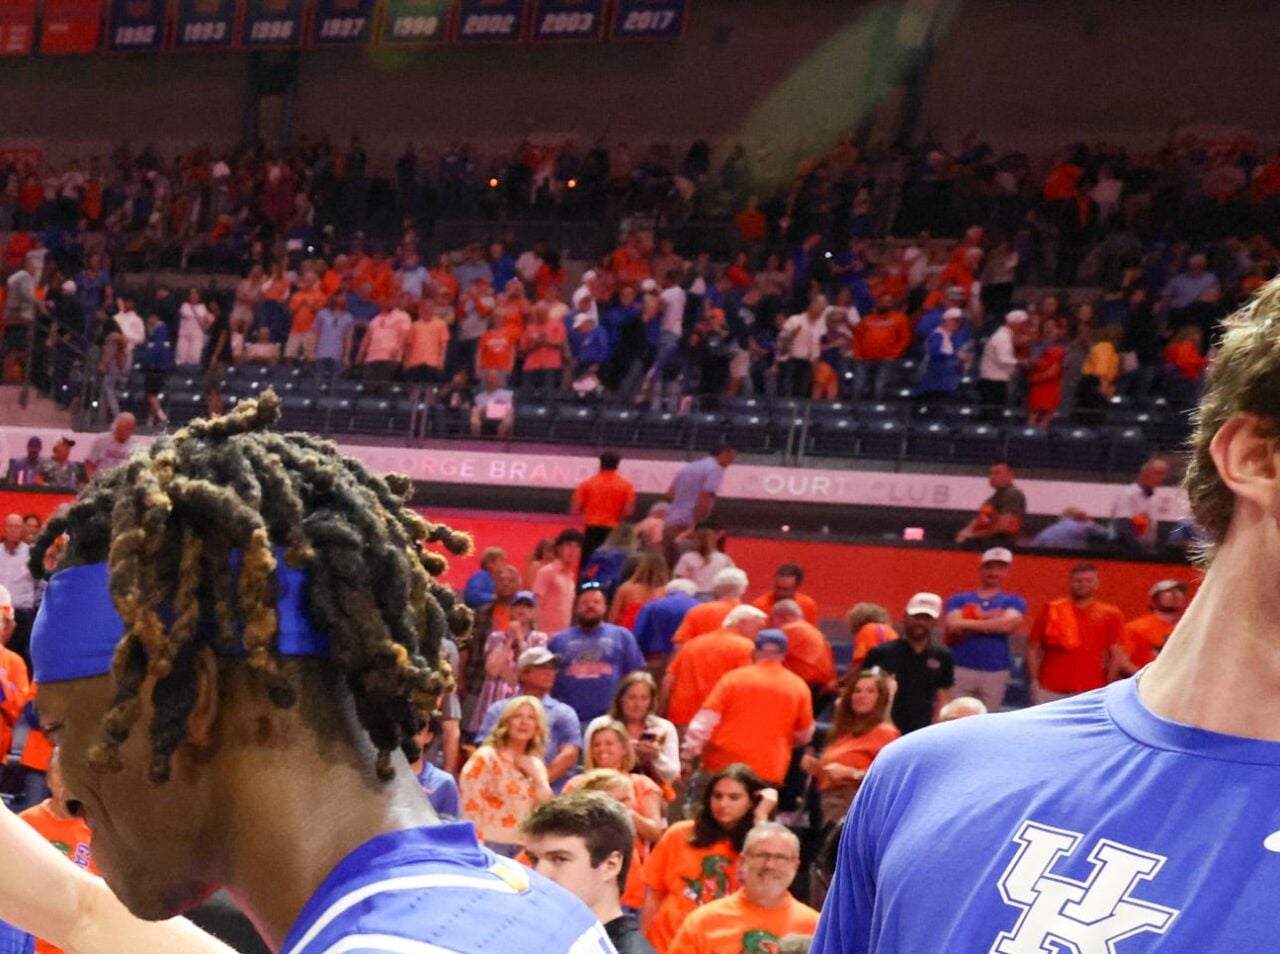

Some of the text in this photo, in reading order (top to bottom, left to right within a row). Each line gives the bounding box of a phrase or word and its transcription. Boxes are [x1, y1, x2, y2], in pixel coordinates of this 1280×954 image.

[540, 12, 593, 33] 2003
[623, 10, 674, 30] 2017
[870, 480, 950, 504] CLUB
